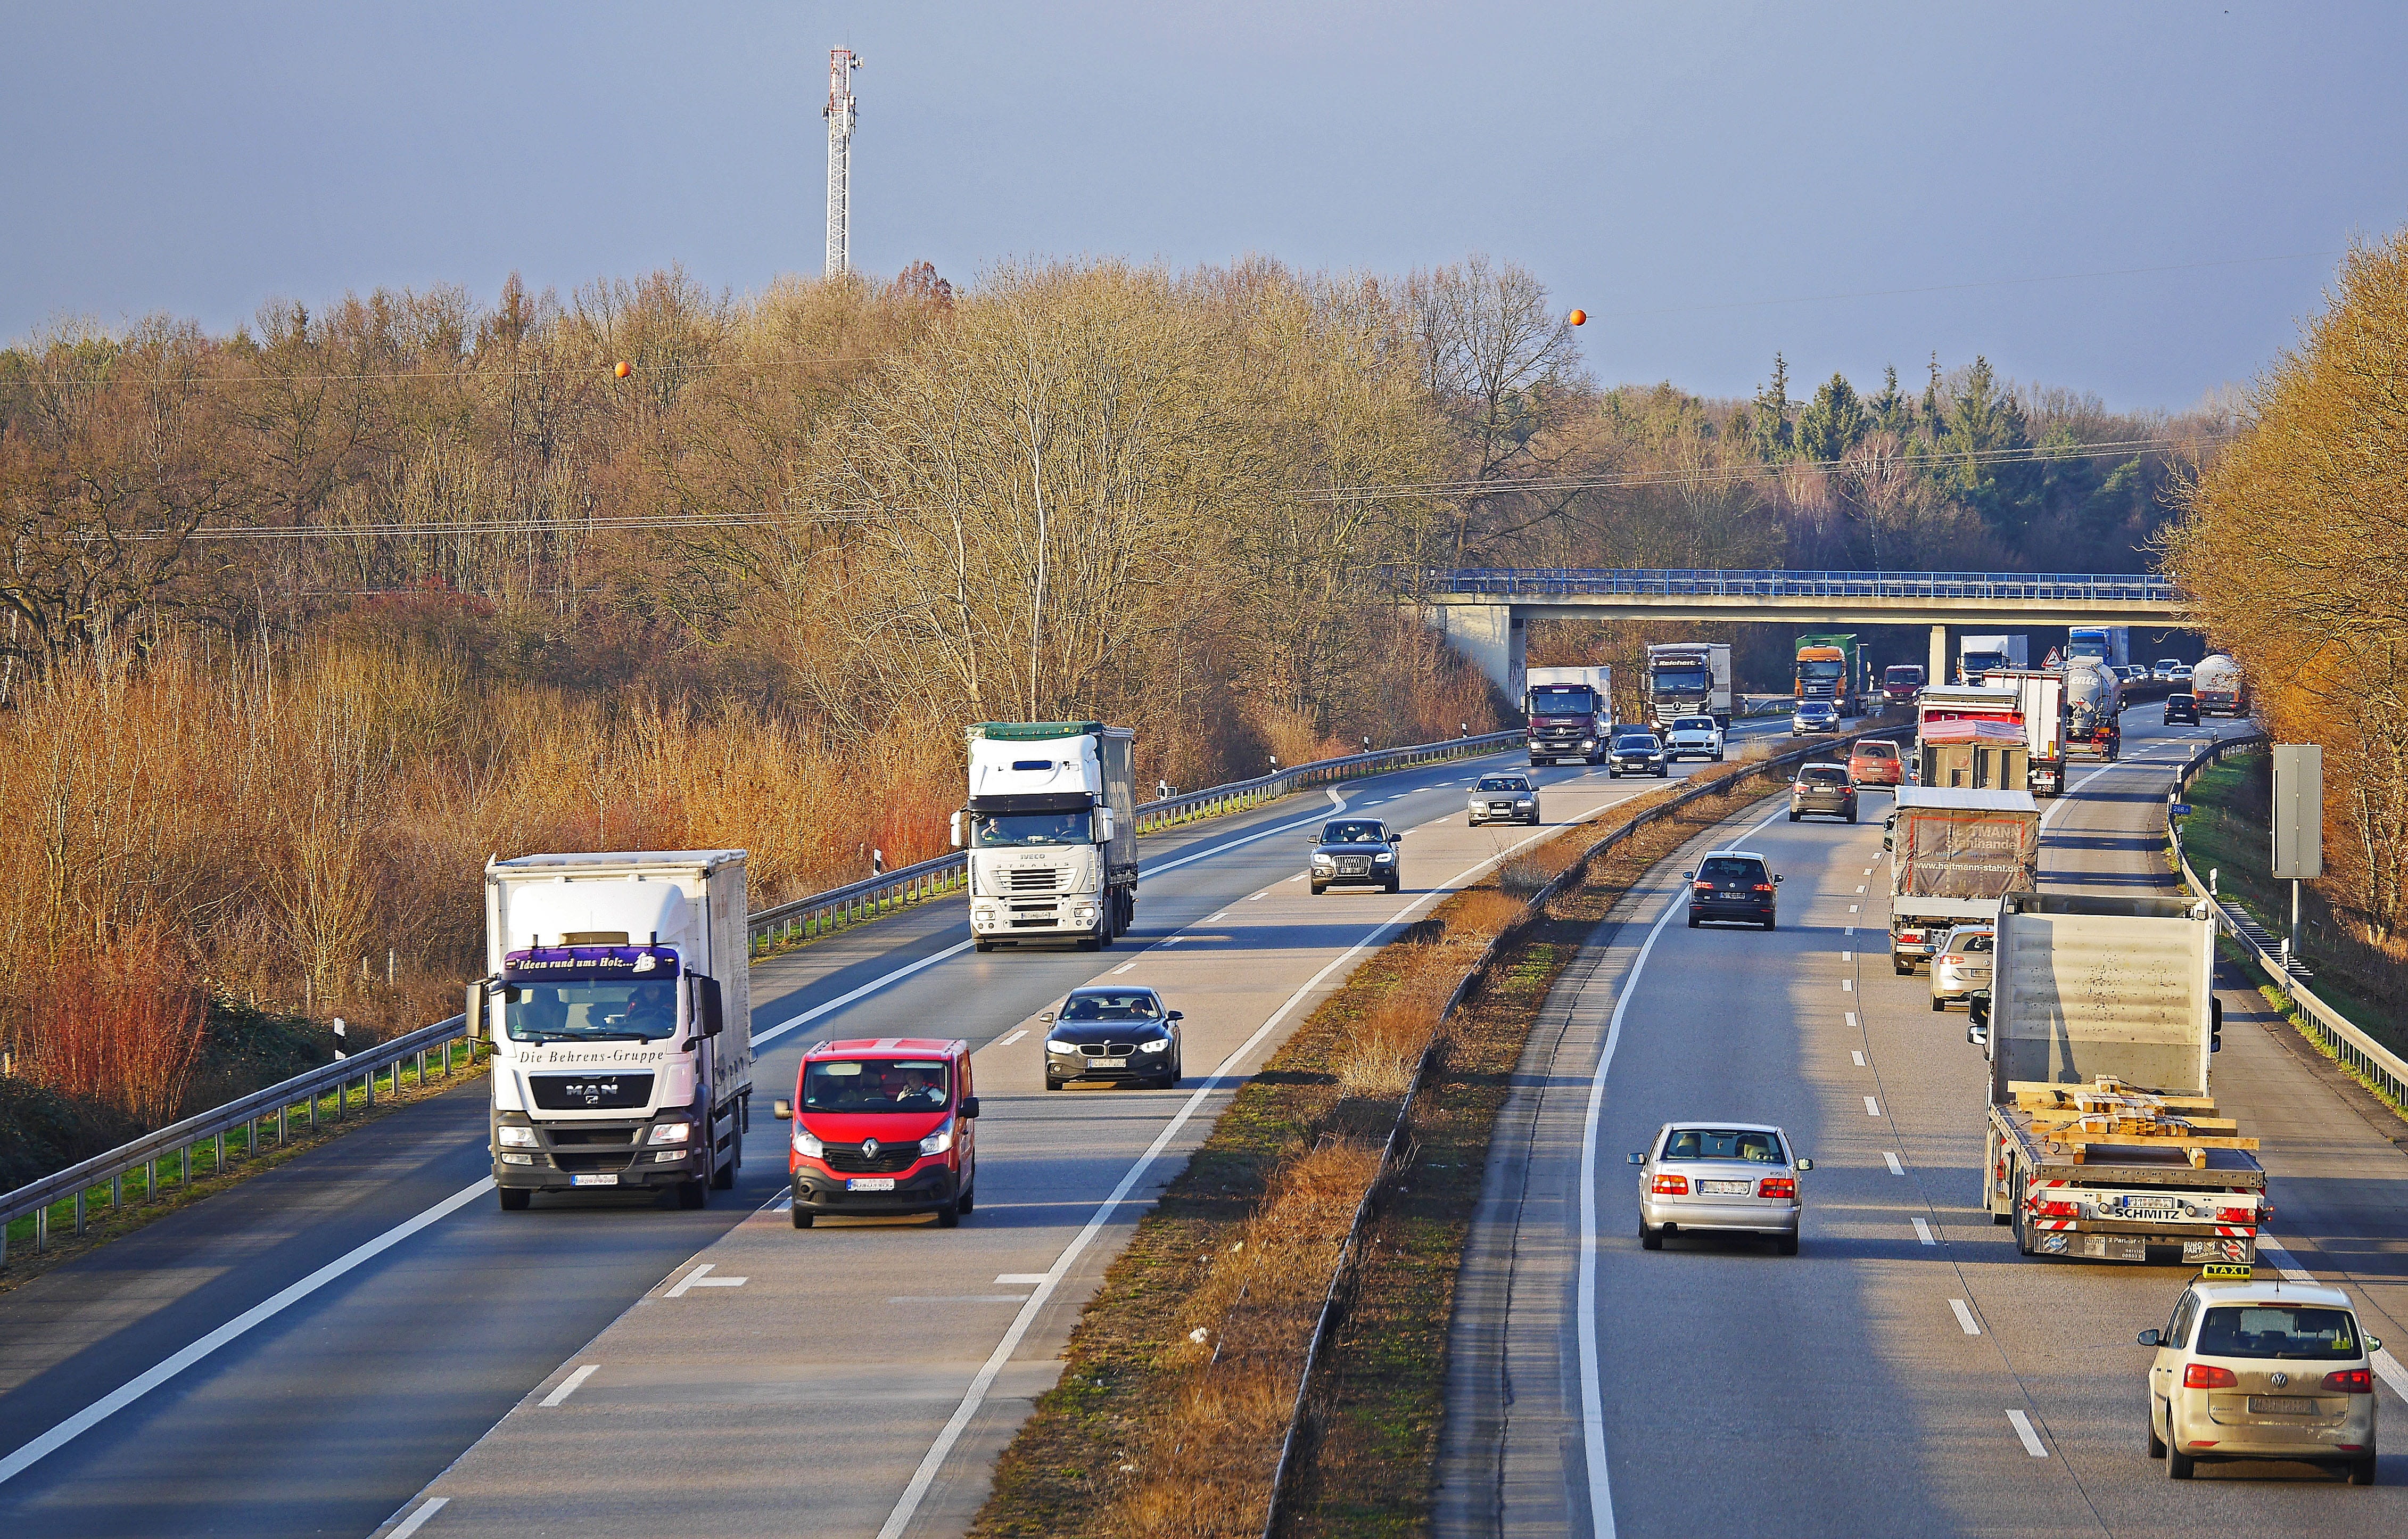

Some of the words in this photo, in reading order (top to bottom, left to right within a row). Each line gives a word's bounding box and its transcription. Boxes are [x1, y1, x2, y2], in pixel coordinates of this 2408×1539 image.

[1913, 862, 2019, 873] www.heitmann-stahl.de
[518, 960, 547, 969] Ideen
[549, 958, 573, 968] rund
[576, 959, 596, 967] ums
[519, 1051, 542, 1063] Die
[549, 1049, 664, 1064] Behrens-Gruppe
[565, 1084, 619, 1096] MAN
[2115, 1208, 2179, 1219] SCHMITZ
[2212, 1266, 2244, 1274] TAXI
